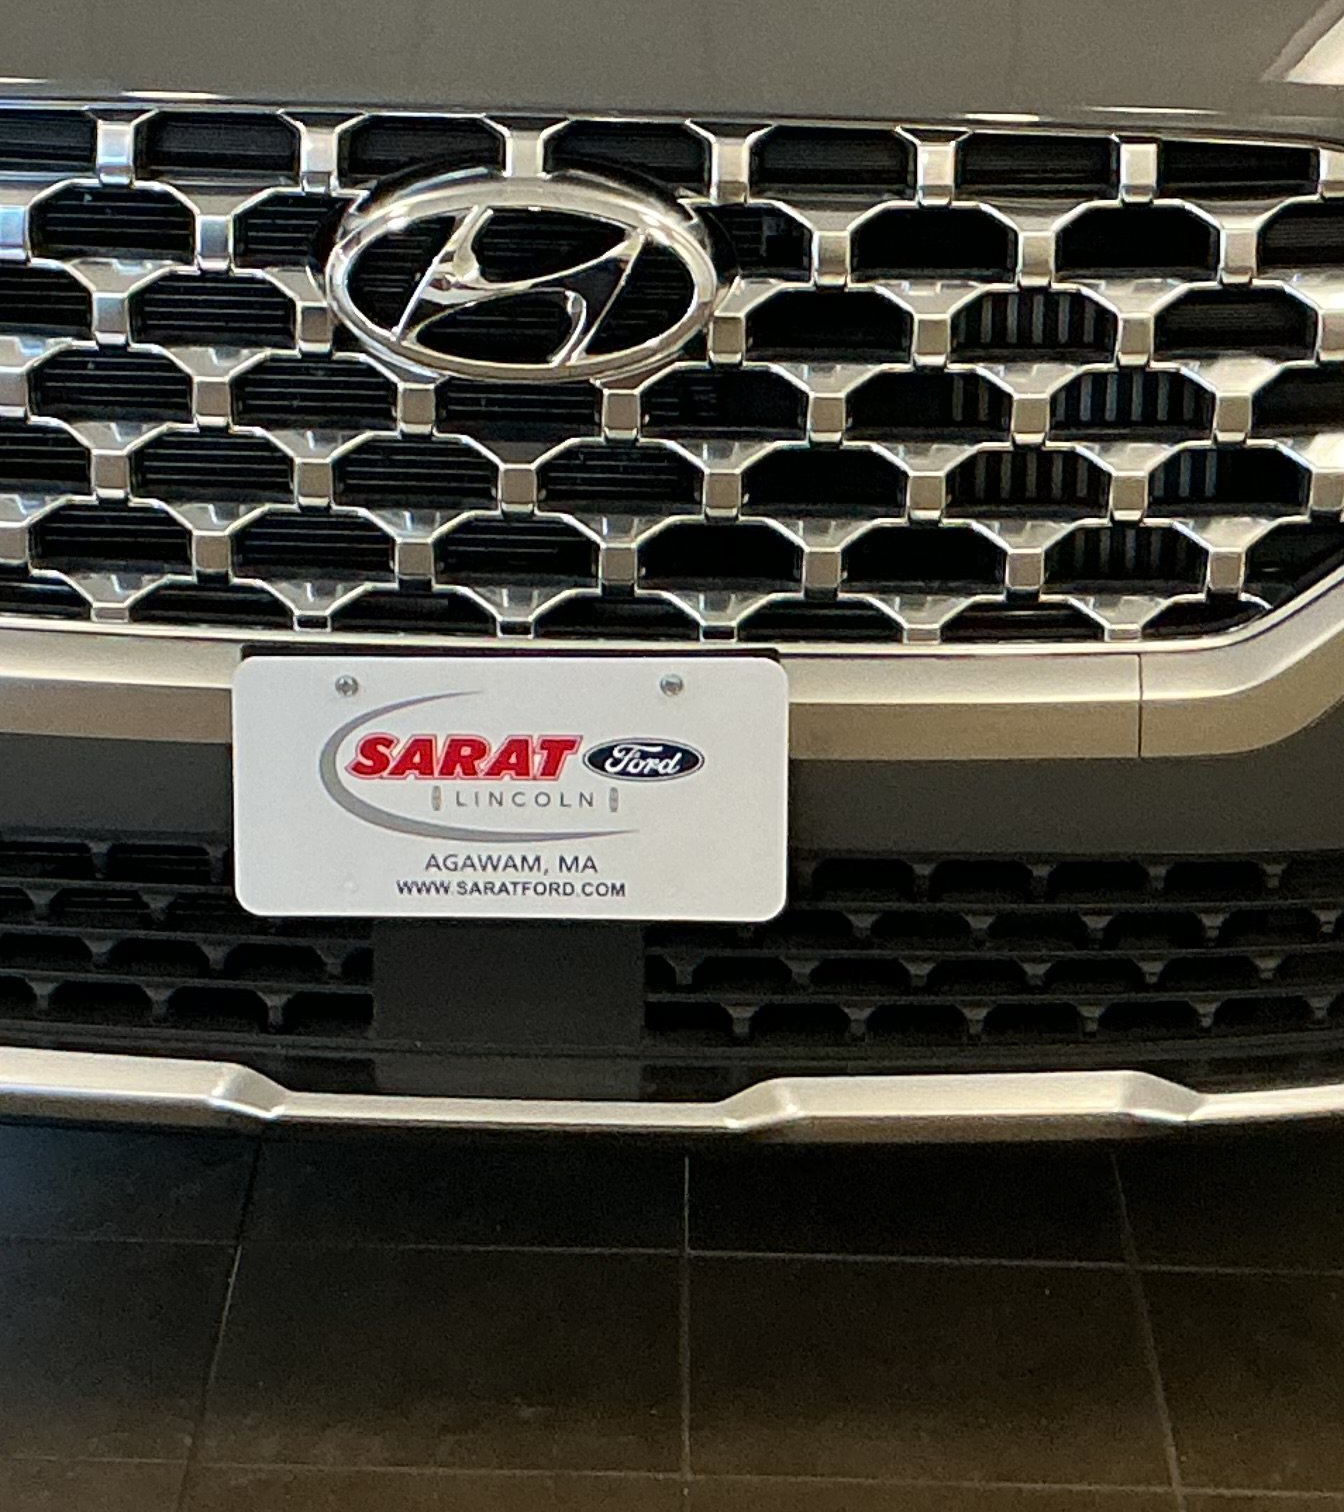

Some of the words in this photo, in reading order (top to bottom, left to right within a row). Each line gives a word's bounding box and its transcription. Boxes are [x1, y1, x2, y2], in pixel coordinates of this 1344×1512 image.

[345, 733, 583, 781] SARAT
[603, 742, 683, 777] Ford
[455, 789, 595, 809] LINCOLN
[424, 853, 550, 877] AGAWAM,
[558, 854, 599, 875] MA
[396, 879, 627, 899] WWW.SARATFORD.COM
